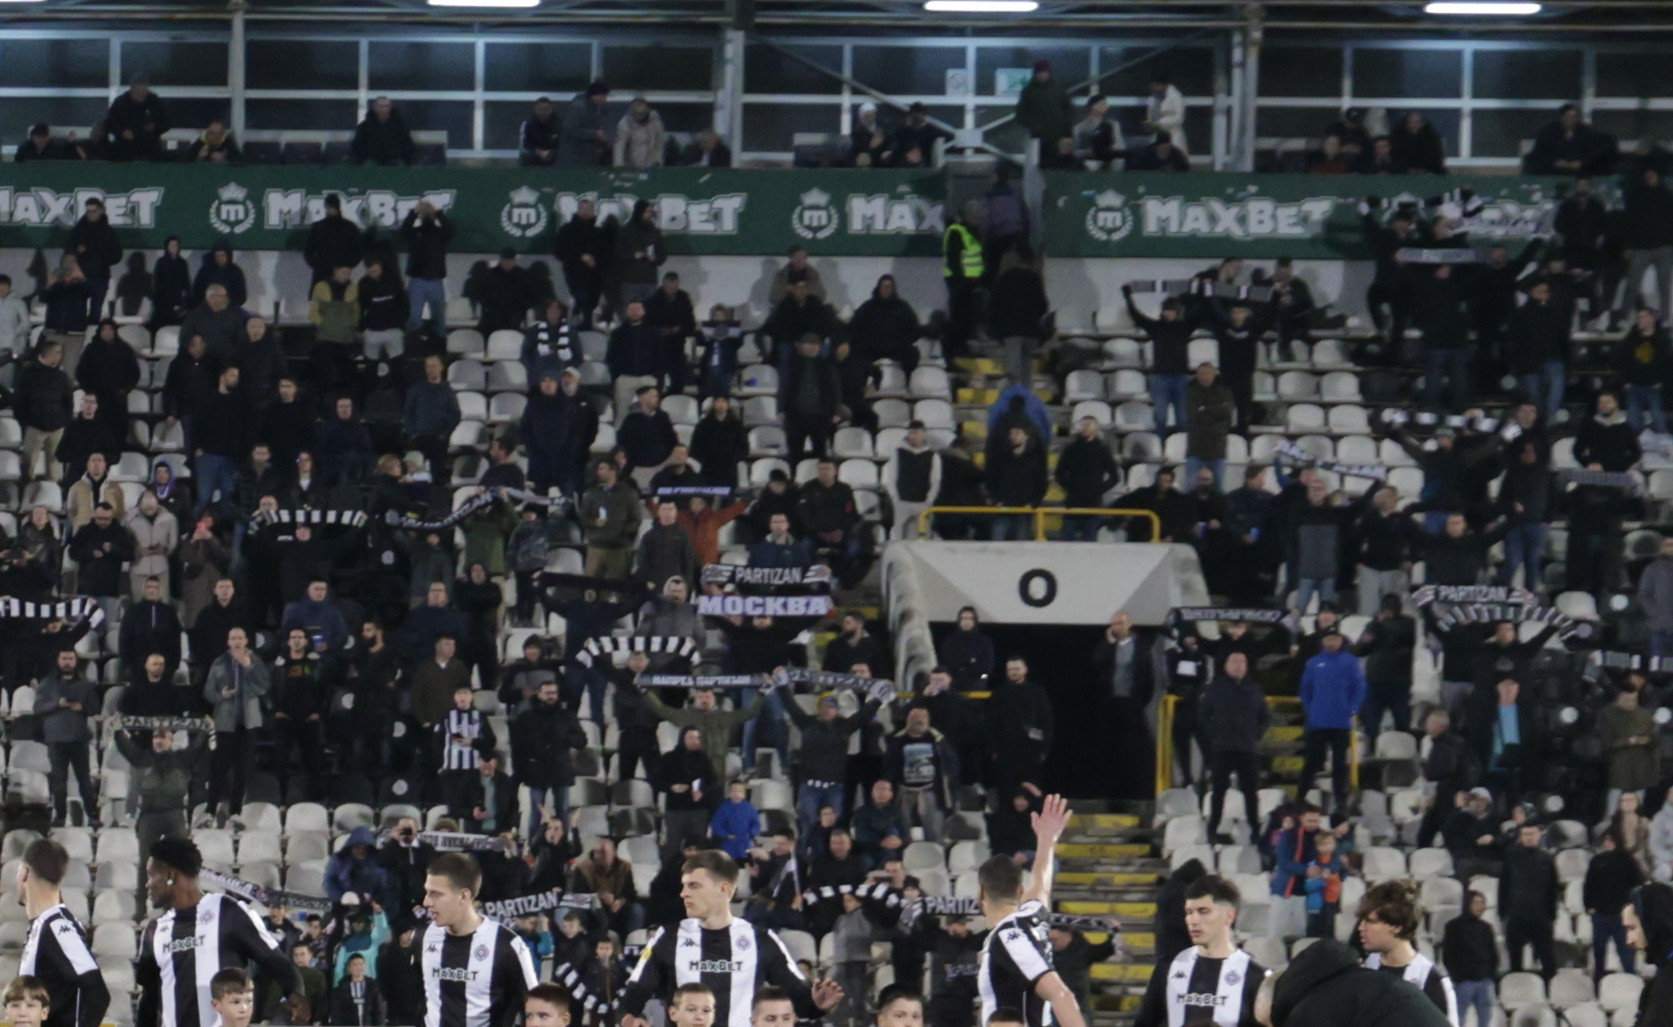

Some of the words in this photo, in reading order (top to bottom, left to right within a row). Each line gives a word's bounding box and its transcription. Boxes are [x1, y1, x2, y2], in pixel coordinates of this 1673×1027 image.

[1142, 195, 1335, 238] MAXBET
[734, 566, 802, 584] PARTIZAN
[1019, 568, 1057, 608] O
[1438, 586, 1508, 602] PARTIZAN
[485, 890, 558, 917] PARTIZAN
[924, 896, 981, 914] PARTIZ
[432, 967, 478, 981] MAXBET
[689, 961, 742, 972] MAXBET
